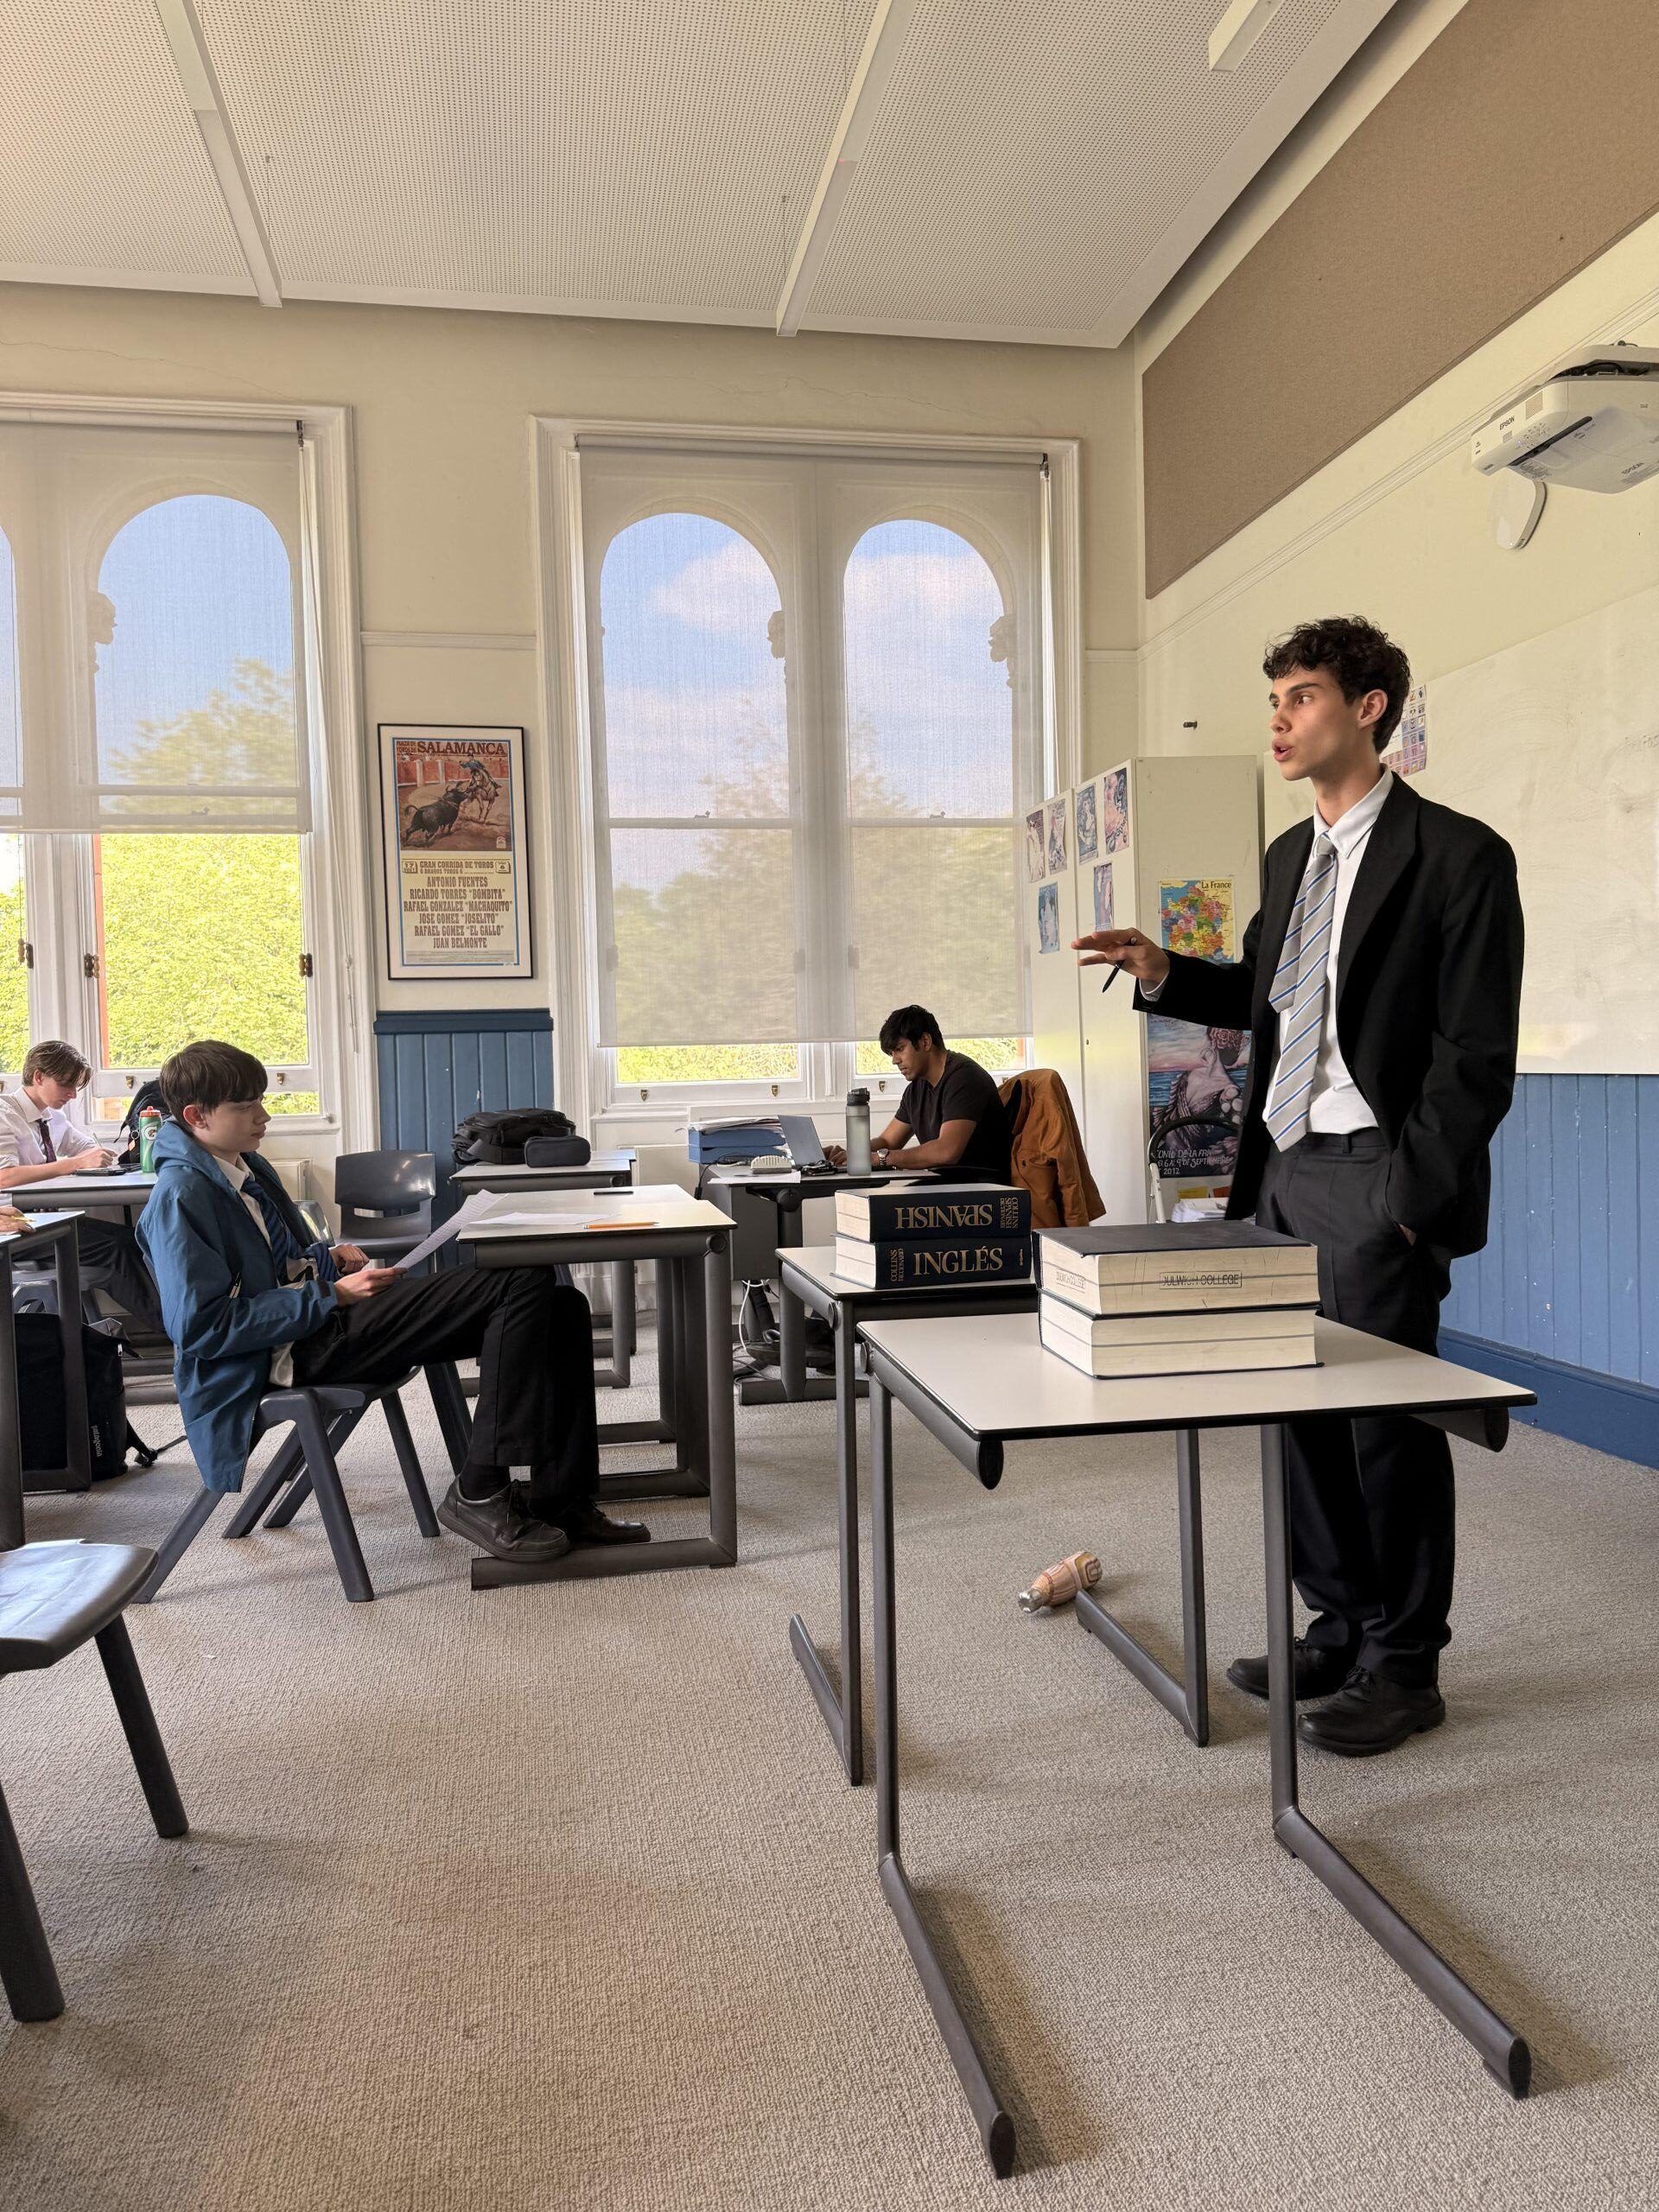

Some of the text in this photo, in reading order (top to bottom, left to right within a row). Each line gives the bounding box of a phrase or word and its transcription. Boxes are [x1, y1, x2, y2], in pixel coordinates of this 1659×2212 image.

[1499, 416, 1515, 430] EPSON
[417, 741, 506, 754] SALAMANCA
[427, 876, 488, 887] ANTONIO FUENTES
[1211, 880, 1231, 889] France
[410, 889, 439, 899] RICARDO
[441, 889, 467, 899] TORRES
[404, 901, 429, 912] RAFAEL
[429, 901, 464, 912] GONZALEZ
[419, 913, 435, 924] JOSE
[436, 913, 460, 925] GOMEZ
[415, 925, 440, 936] RAFAEL
[442, 925, 465, 937] GOMEZ
[433, 938, 487, 949] JUAN BELMONTE
[1189, 1149, 1197, 1158] LA
[895, 1204, 993, 1230] SPANISH
[912, 1245, 1003, 1275] INGLÉS
[1201, 1274, 1239, 1286] COLLEGE
[91, 1425, 103, 1458] patagonia
